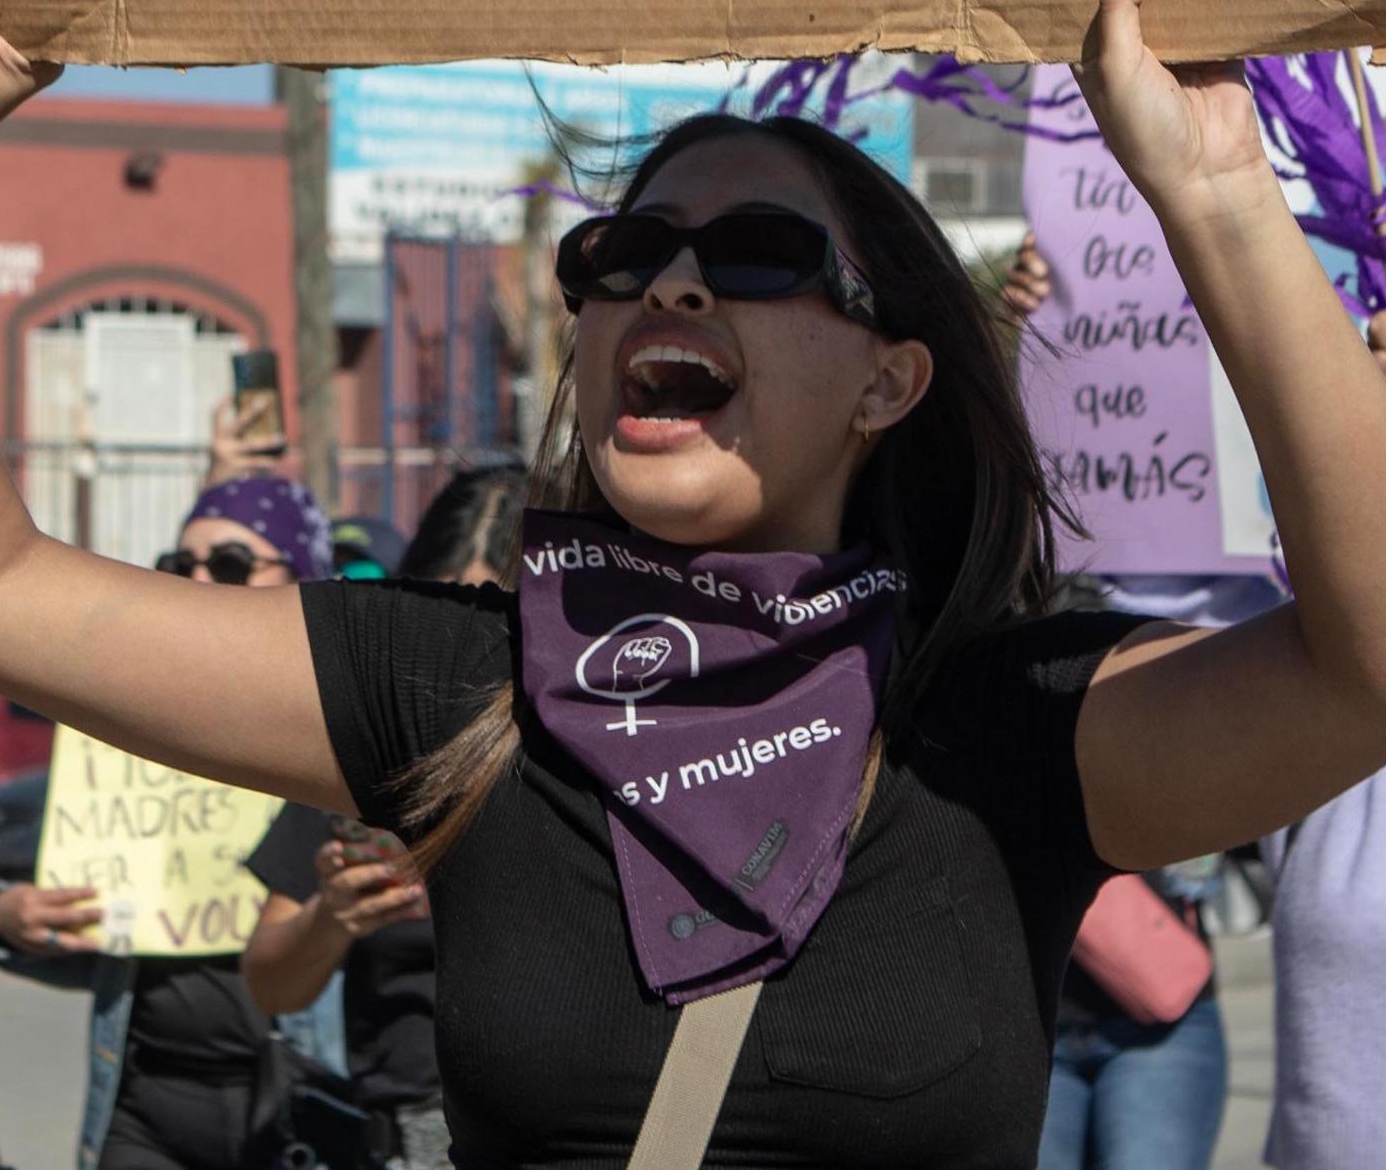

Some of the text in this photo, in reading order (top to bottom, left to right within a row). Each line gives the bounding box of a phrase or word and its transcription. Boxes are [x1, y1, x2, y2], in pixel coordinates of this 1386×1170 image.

[1063, 300, 1199, 351] niñas
[1074, 383, 1148, 428] que
[523, 538, 606, 577] vida
[606, 543, 685, 584] libre
[690, 570, 742, 603] de
[645, 772, 670, 805] y
[678, 717, 843, 790] mujeres.
[54, 787, 240, 847] MADRES
[164, 848, 189, 888] A
